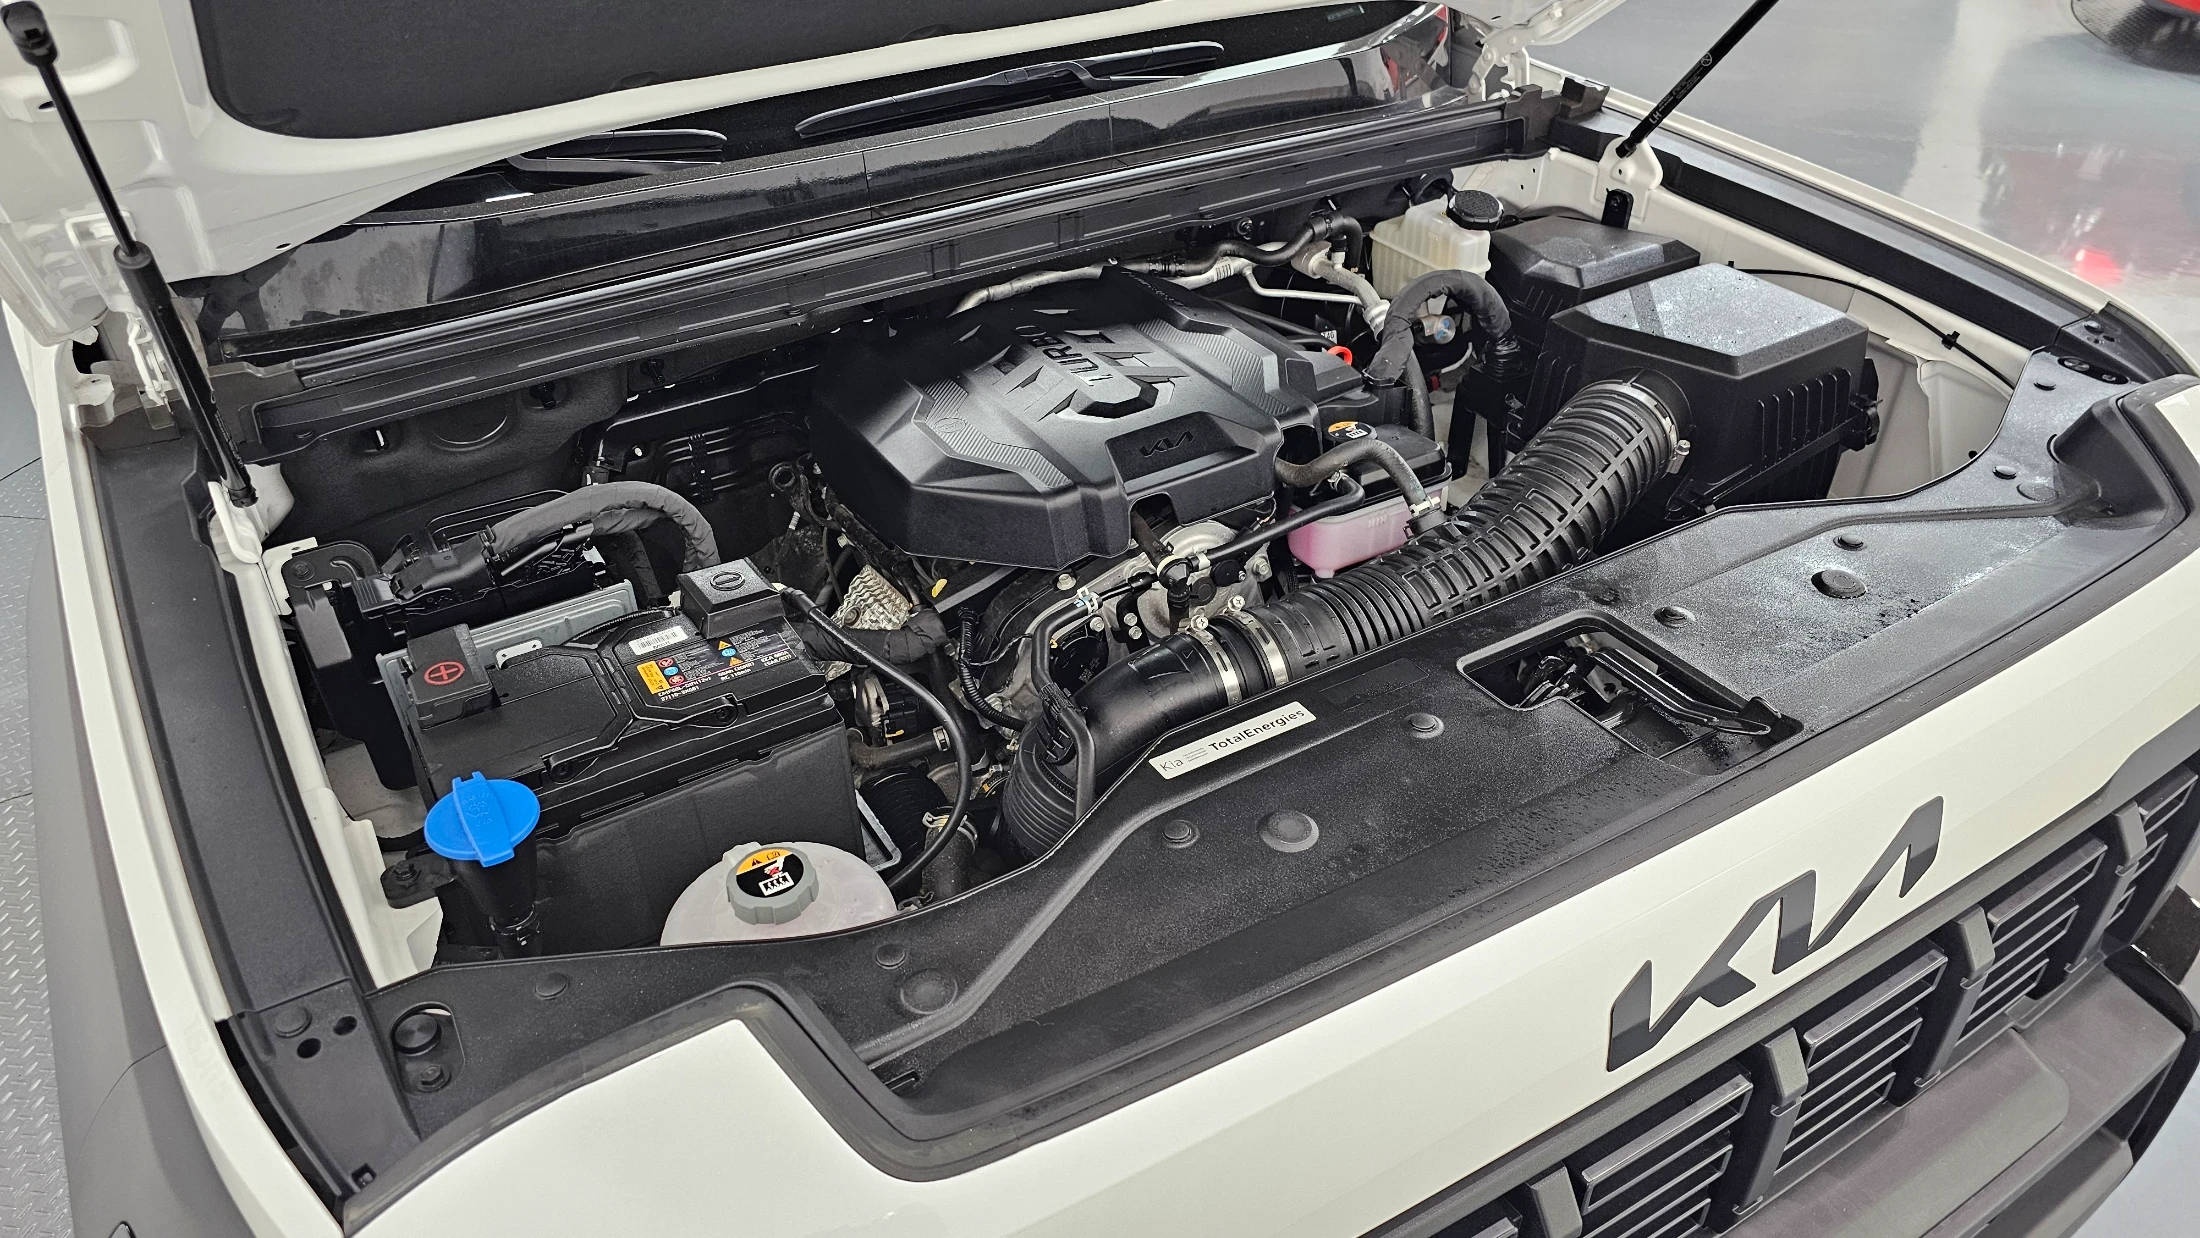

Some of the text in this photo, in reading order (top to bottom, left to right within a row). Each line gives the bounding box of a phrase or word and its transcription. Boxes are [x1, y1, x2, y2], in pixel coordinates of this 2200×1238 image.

[1649, 111, 1662, 124] LH
[1014, 325, 1113, 386] TURBO
[1159, 709, 1305, 771] Kia TotalEnergies
